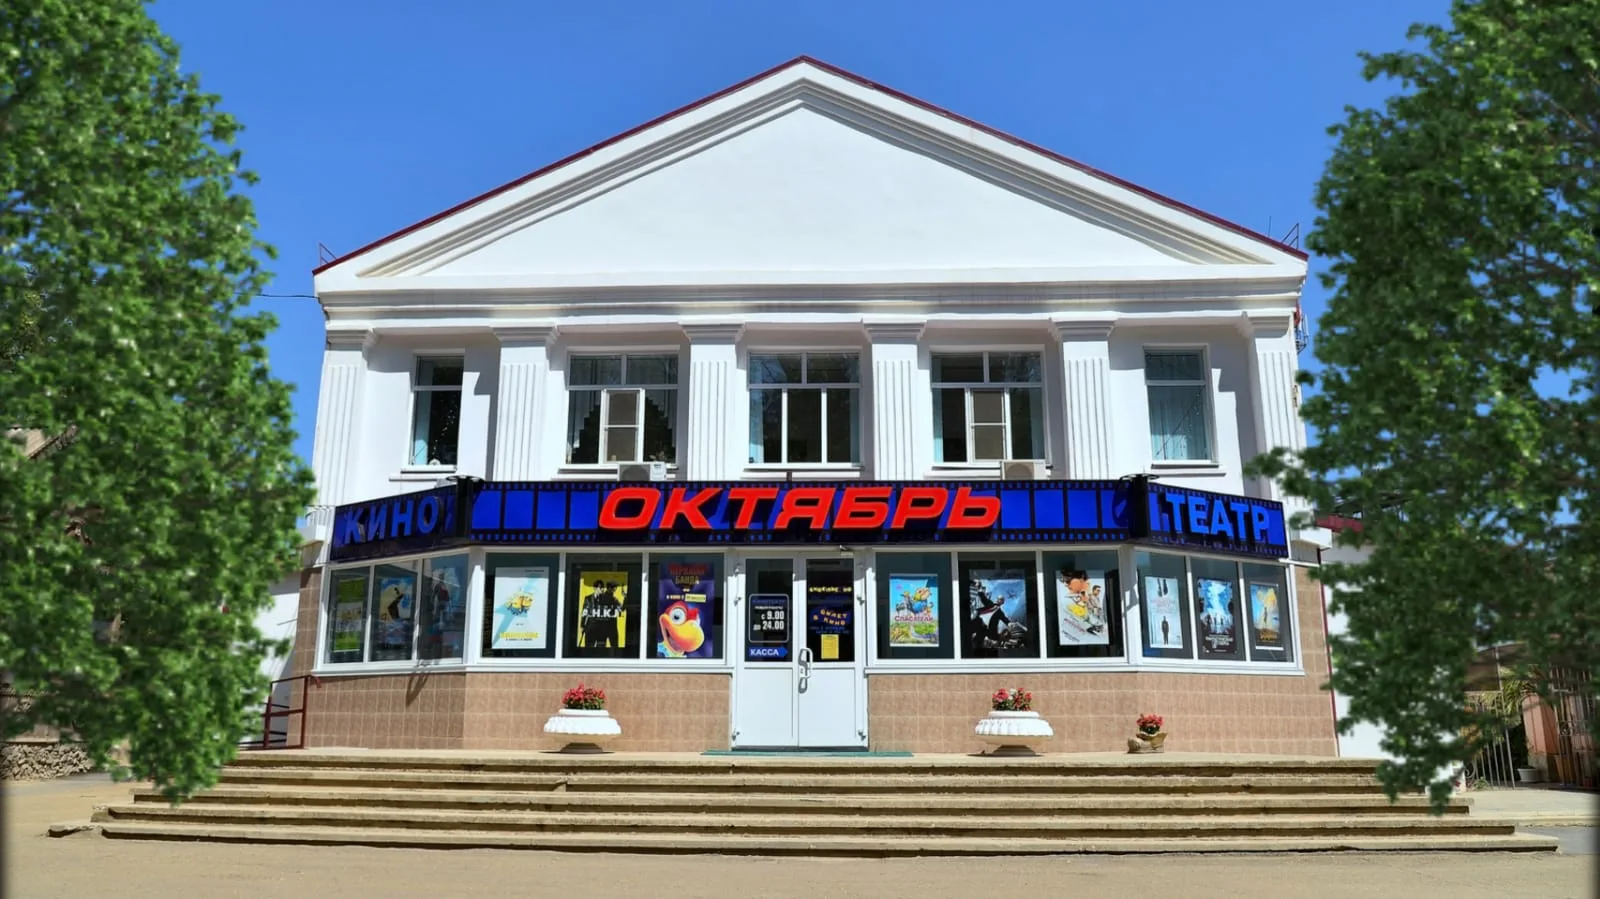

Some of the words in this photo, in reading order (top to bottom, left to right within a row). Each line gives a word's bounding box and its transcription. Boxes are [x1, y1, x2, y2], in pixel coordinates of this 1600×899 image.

[344, 496, 438, 544] КИНО
[598, 487, 1001, 530] ОКТЯБРЬ
[1166, 493, 1270, 539] ТЕАТР
[762, 621, 785, 630] 24.00
[767, 610, 785, 620] 9.00
[750, 648, 779, 656] КАССА
